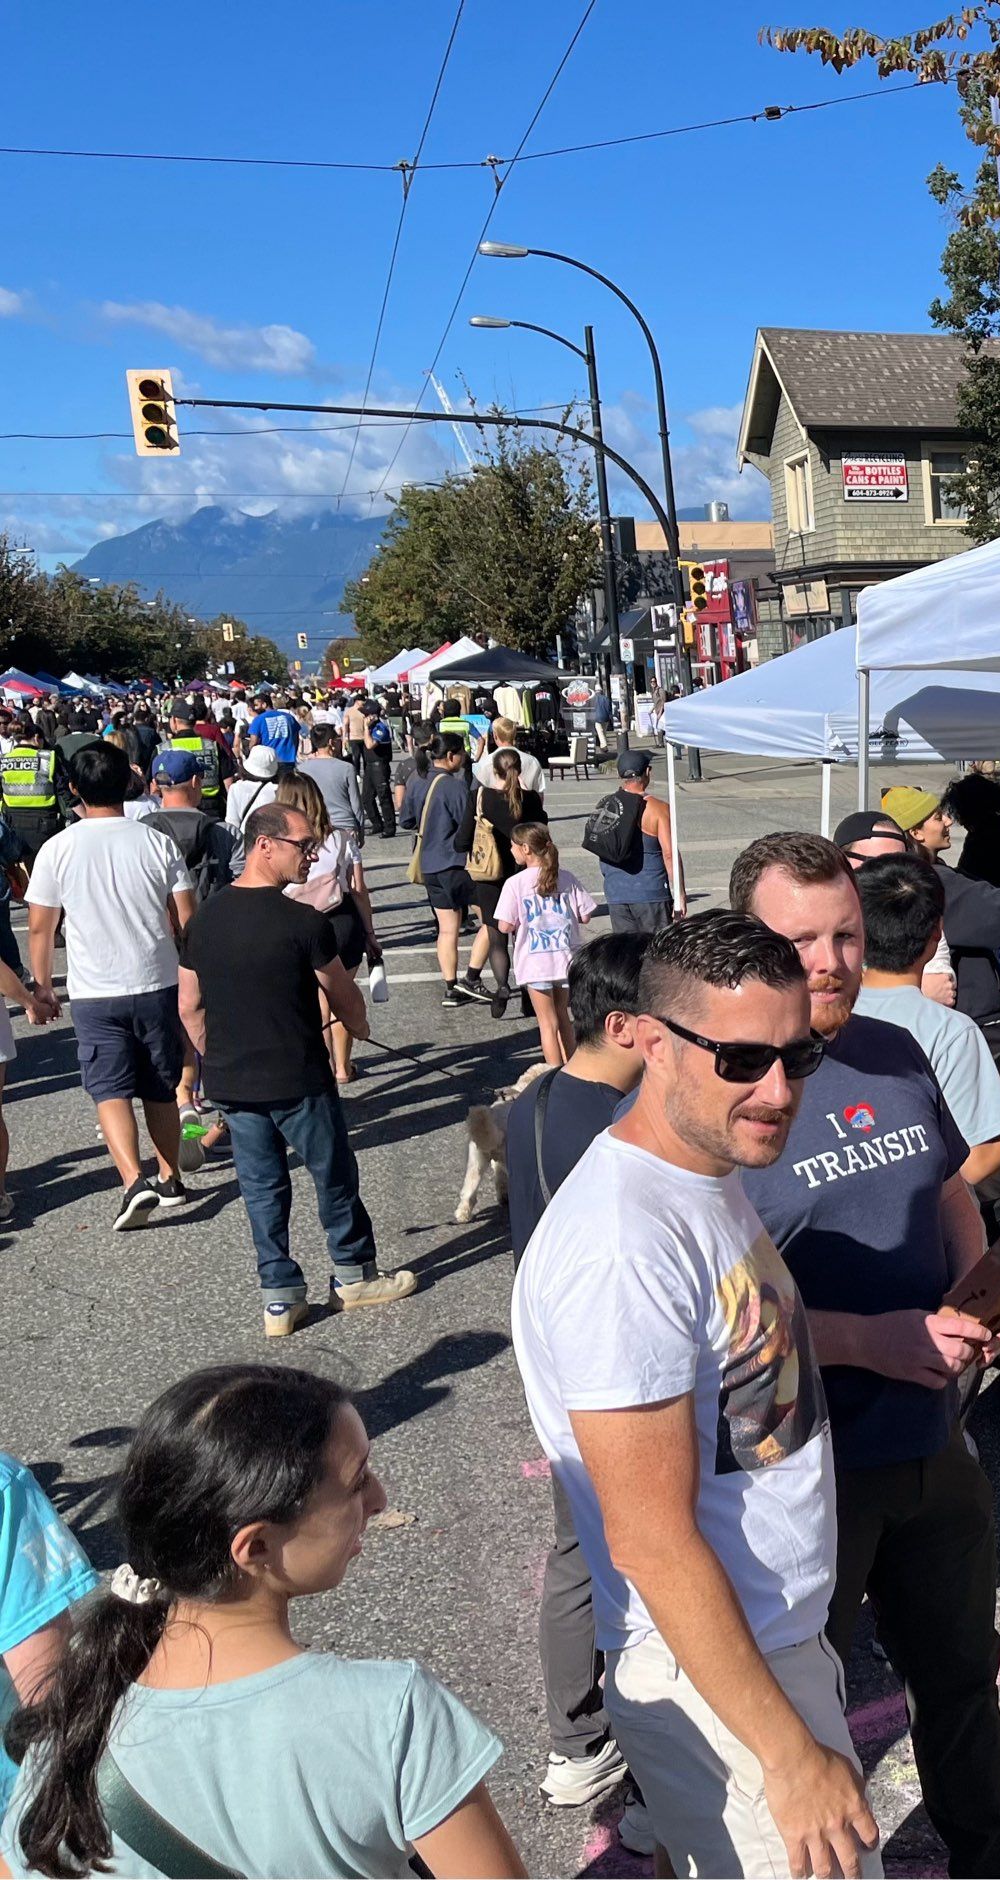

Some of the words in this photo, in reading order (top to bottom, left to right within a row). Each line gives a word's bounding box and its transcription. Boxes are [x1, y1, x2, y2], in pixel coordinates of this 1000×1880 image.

[865, 466, 901, 475] BOTTLES
[846, 475, 869, 484] CANS
[871, 476, 877, 484] &
[878, 475, 904, 484] PAINT
[0, 762, 38, 770] POLICE
[826, 1112, 847, 1139] I
[793, 1124, 929, 1189] TRANSIT
